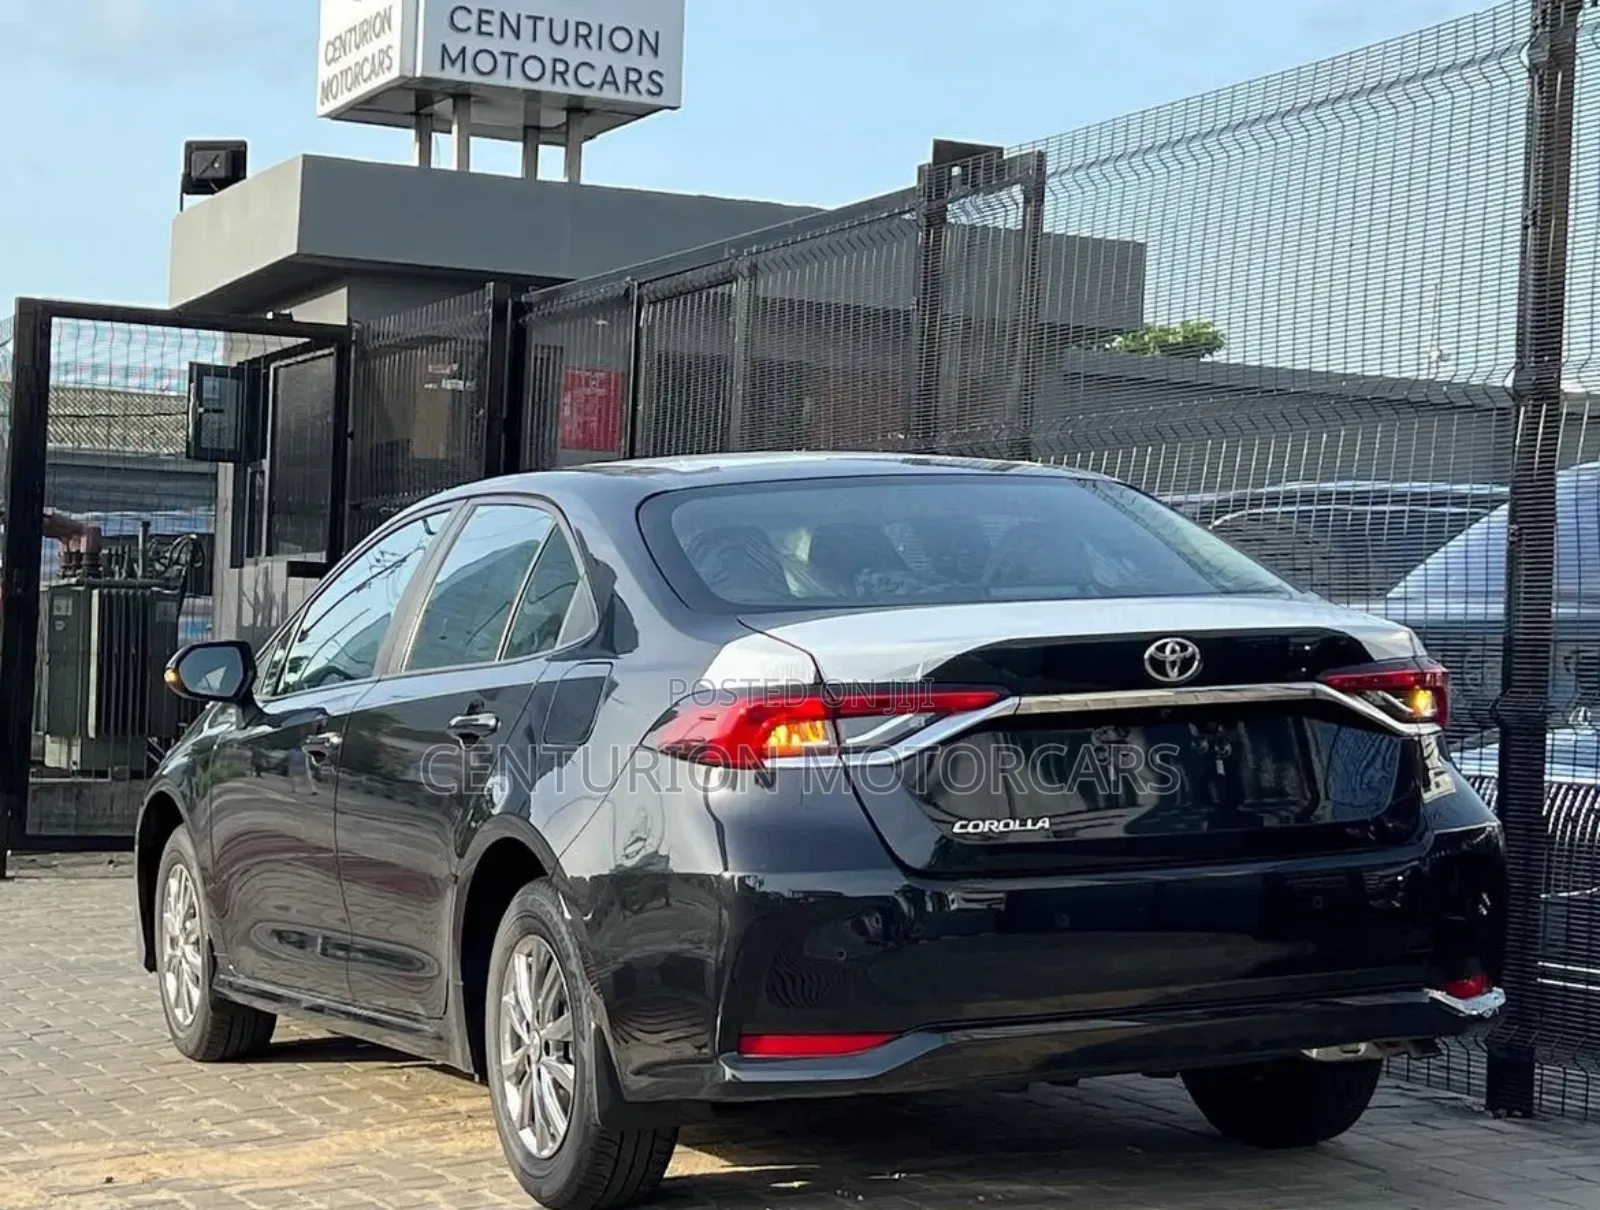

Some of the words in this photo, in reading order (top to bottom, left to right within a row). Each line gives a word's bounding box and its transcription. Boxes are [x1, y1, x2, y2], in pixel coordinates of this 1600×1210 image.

[325, 4, 393, 66] CENTURION
[450, 5, 660, 58] CENTURION
[320, 43, 393, 106] MOTORCARS
[440, 44, 665, 98] MOTORCARS
[952, 817, 1050, 833] COROLLA
